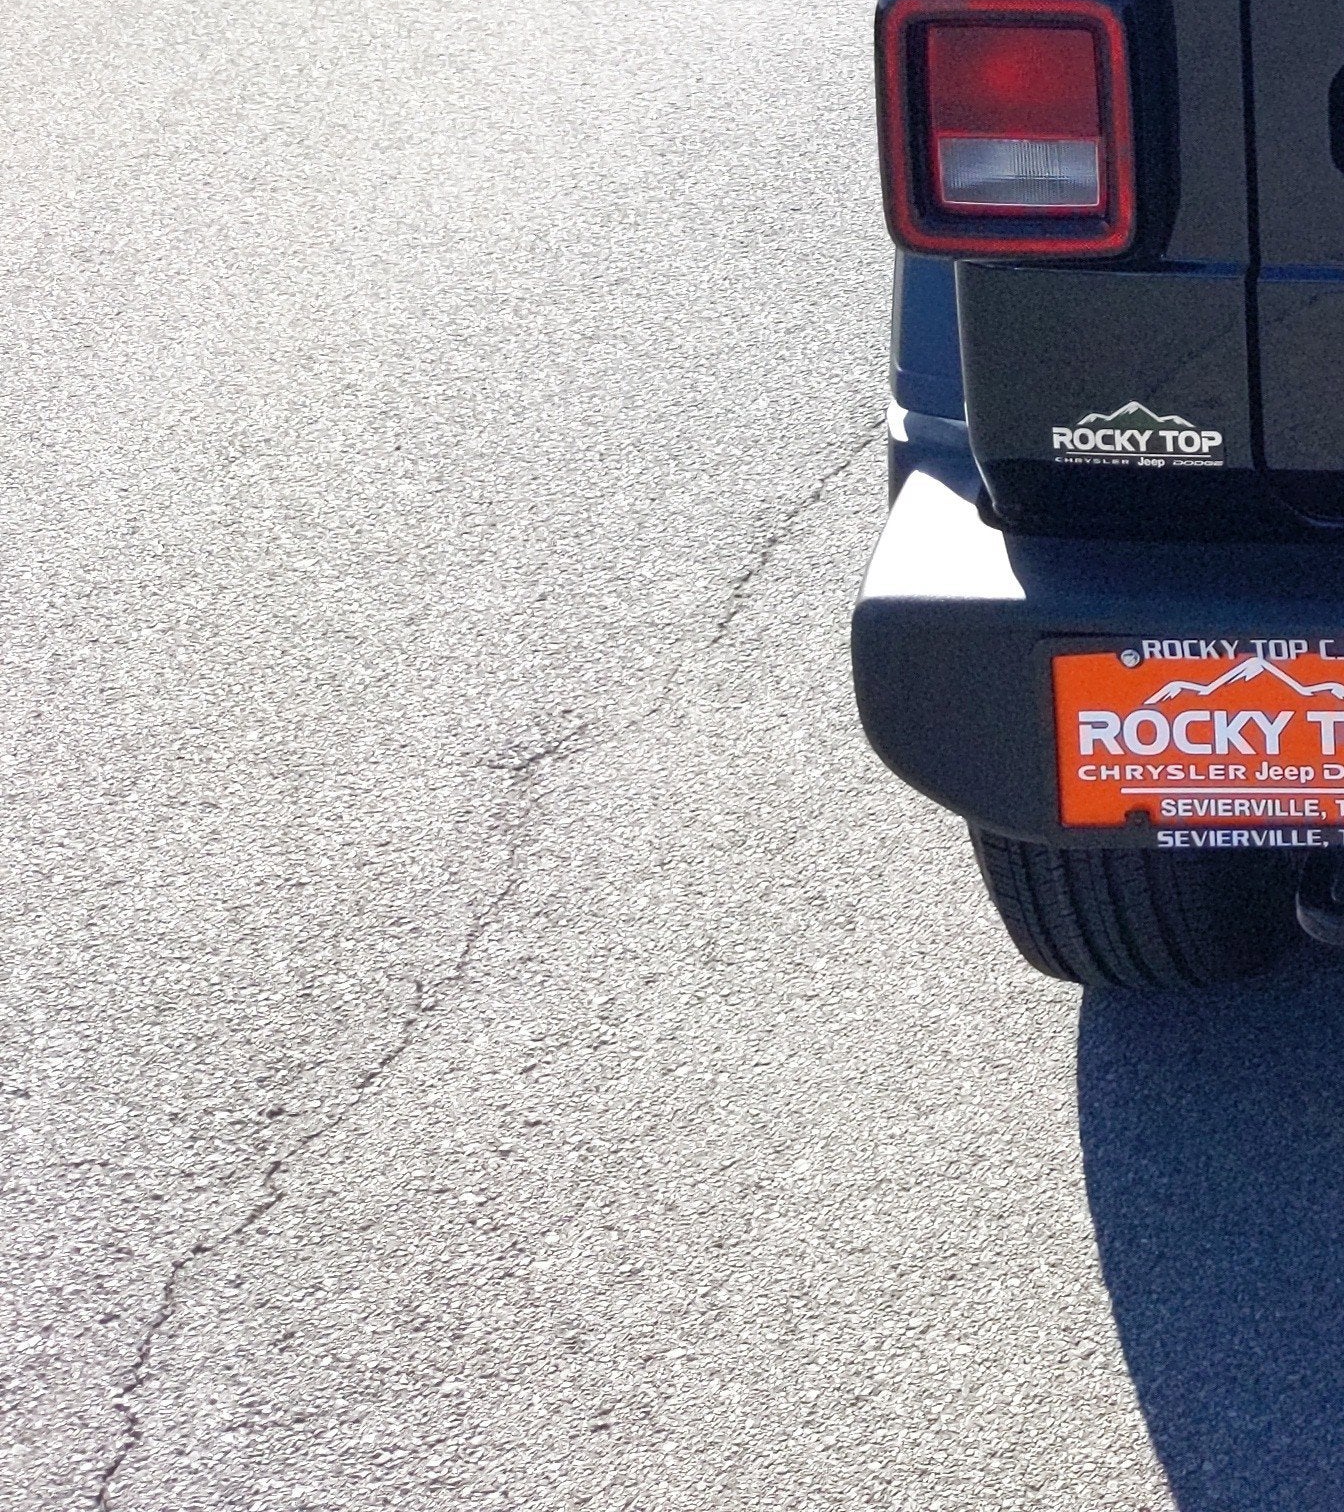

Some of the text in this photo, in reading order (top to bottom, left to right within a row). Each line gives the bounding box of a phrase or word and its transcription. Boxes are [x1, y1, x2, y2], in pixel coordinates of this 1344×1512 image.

[1052, 426, 1223, 453] ROCKY TOP
[1055, 456, 1224, 468] CHRYSLER Jeep DODGE
[1142, 639, 1239, 661] ROCKY
[1250, 639, 1308, 661] TOP
[1078, 710, 1295, 756] ROCKY
[1077, 764, 1247, 781] CHRYSLER
[1255, 762, 1316, 782] Jeep
[1160, 799, 1327, 820] SEVIERVILLE,
[1157, 829, 1329, 849] SEVIERVILLE,
